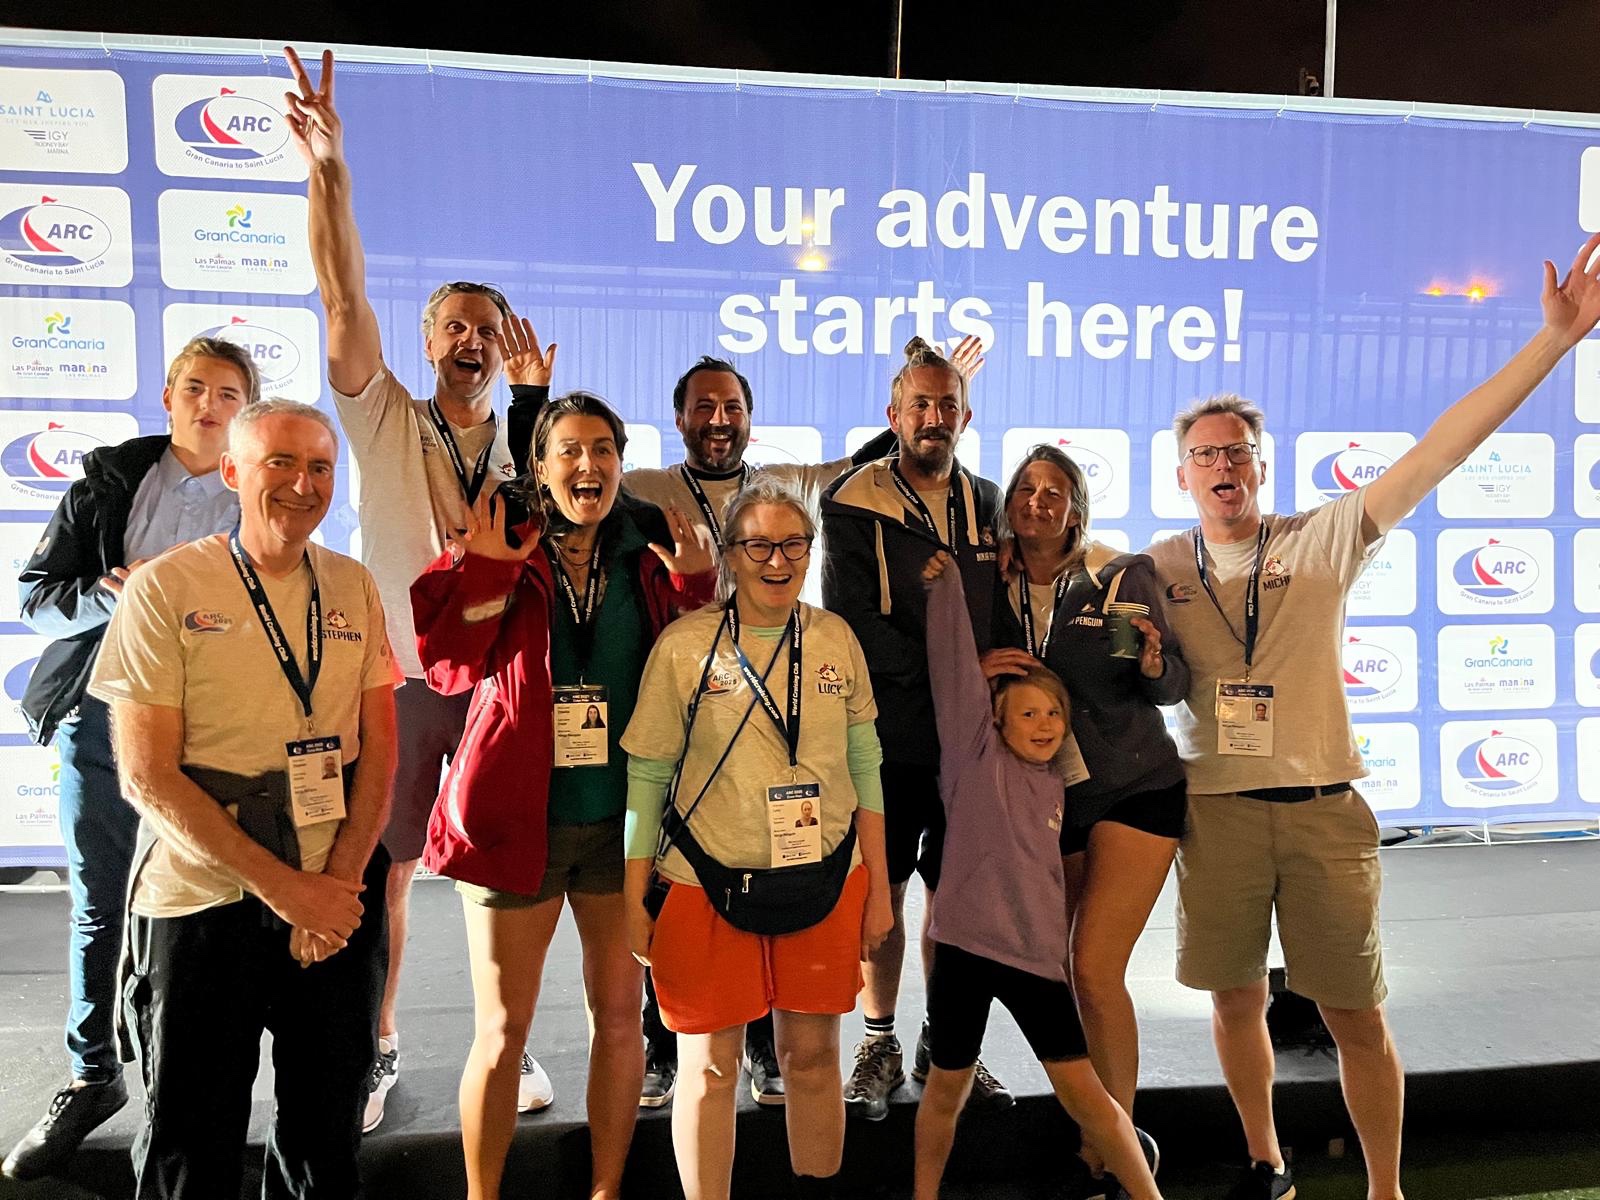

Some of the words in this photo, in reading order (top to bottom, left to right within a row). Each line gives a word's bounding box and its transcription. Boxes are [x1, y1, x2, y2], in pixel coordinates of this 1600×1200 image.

[0, 104, 43, 116] SAINT
[50, 107, 96, 118] LUCIA
[226, 115, 272, 132] ARC
[49, 131, 69, 141] IGY
[185, 149, 203, 162] Gran
[204, 157, 234, 168] Canaria
[244, 160, 264, 168] Saint
[265, 153, 284, 165] Lucia
[631, 161, 845, 246] Your
[876, 171, 1320, 263] adventure
[48, 223, 94, 240] ARC
[194, 229, 286, 245] GranCanaria
[5, 256, 23, 269] Gran
[24, 264, 54, 275] Canaria
[64, 267, 84, 275] Saint
[85, 259, 105, 271] Lucia
[209, 257, 236, 266] Palmas
[715, 278, 995, 355] starts
[1028, 281, 1244, 362] here!
[12, 336, 105, 350] GranCanaria
[26, 364, 54, 372] Palmas
[53, 449, 84, 465] AR
[1460, 464, 1493, 473] SAINT
[1498, 464, 1532, 473] LUCIA
[10, 483, 29, 495] Gran
[30, 490, 60, 501] Canaria
[1496, 484, 1511, 492] IGY
[1492, 561, 1526, 574] ARC
[1075, 616, 1103, 627] PENGUIN
[320, 629, 362, 642] STEPHEN
[1353, 659, 1389, 673] ARC
[1464, 657, 1533, 668] GranCanaria
[713, 673, 730, 682] ARC
[792, 671, 800, 698] Cruising
[743, 666, 780, 720] worldcruising.com
[817, 682, 844, 696] LUCY
[791, 696, 799, 716] World
[1495, 752, 1530, 767] ARC
